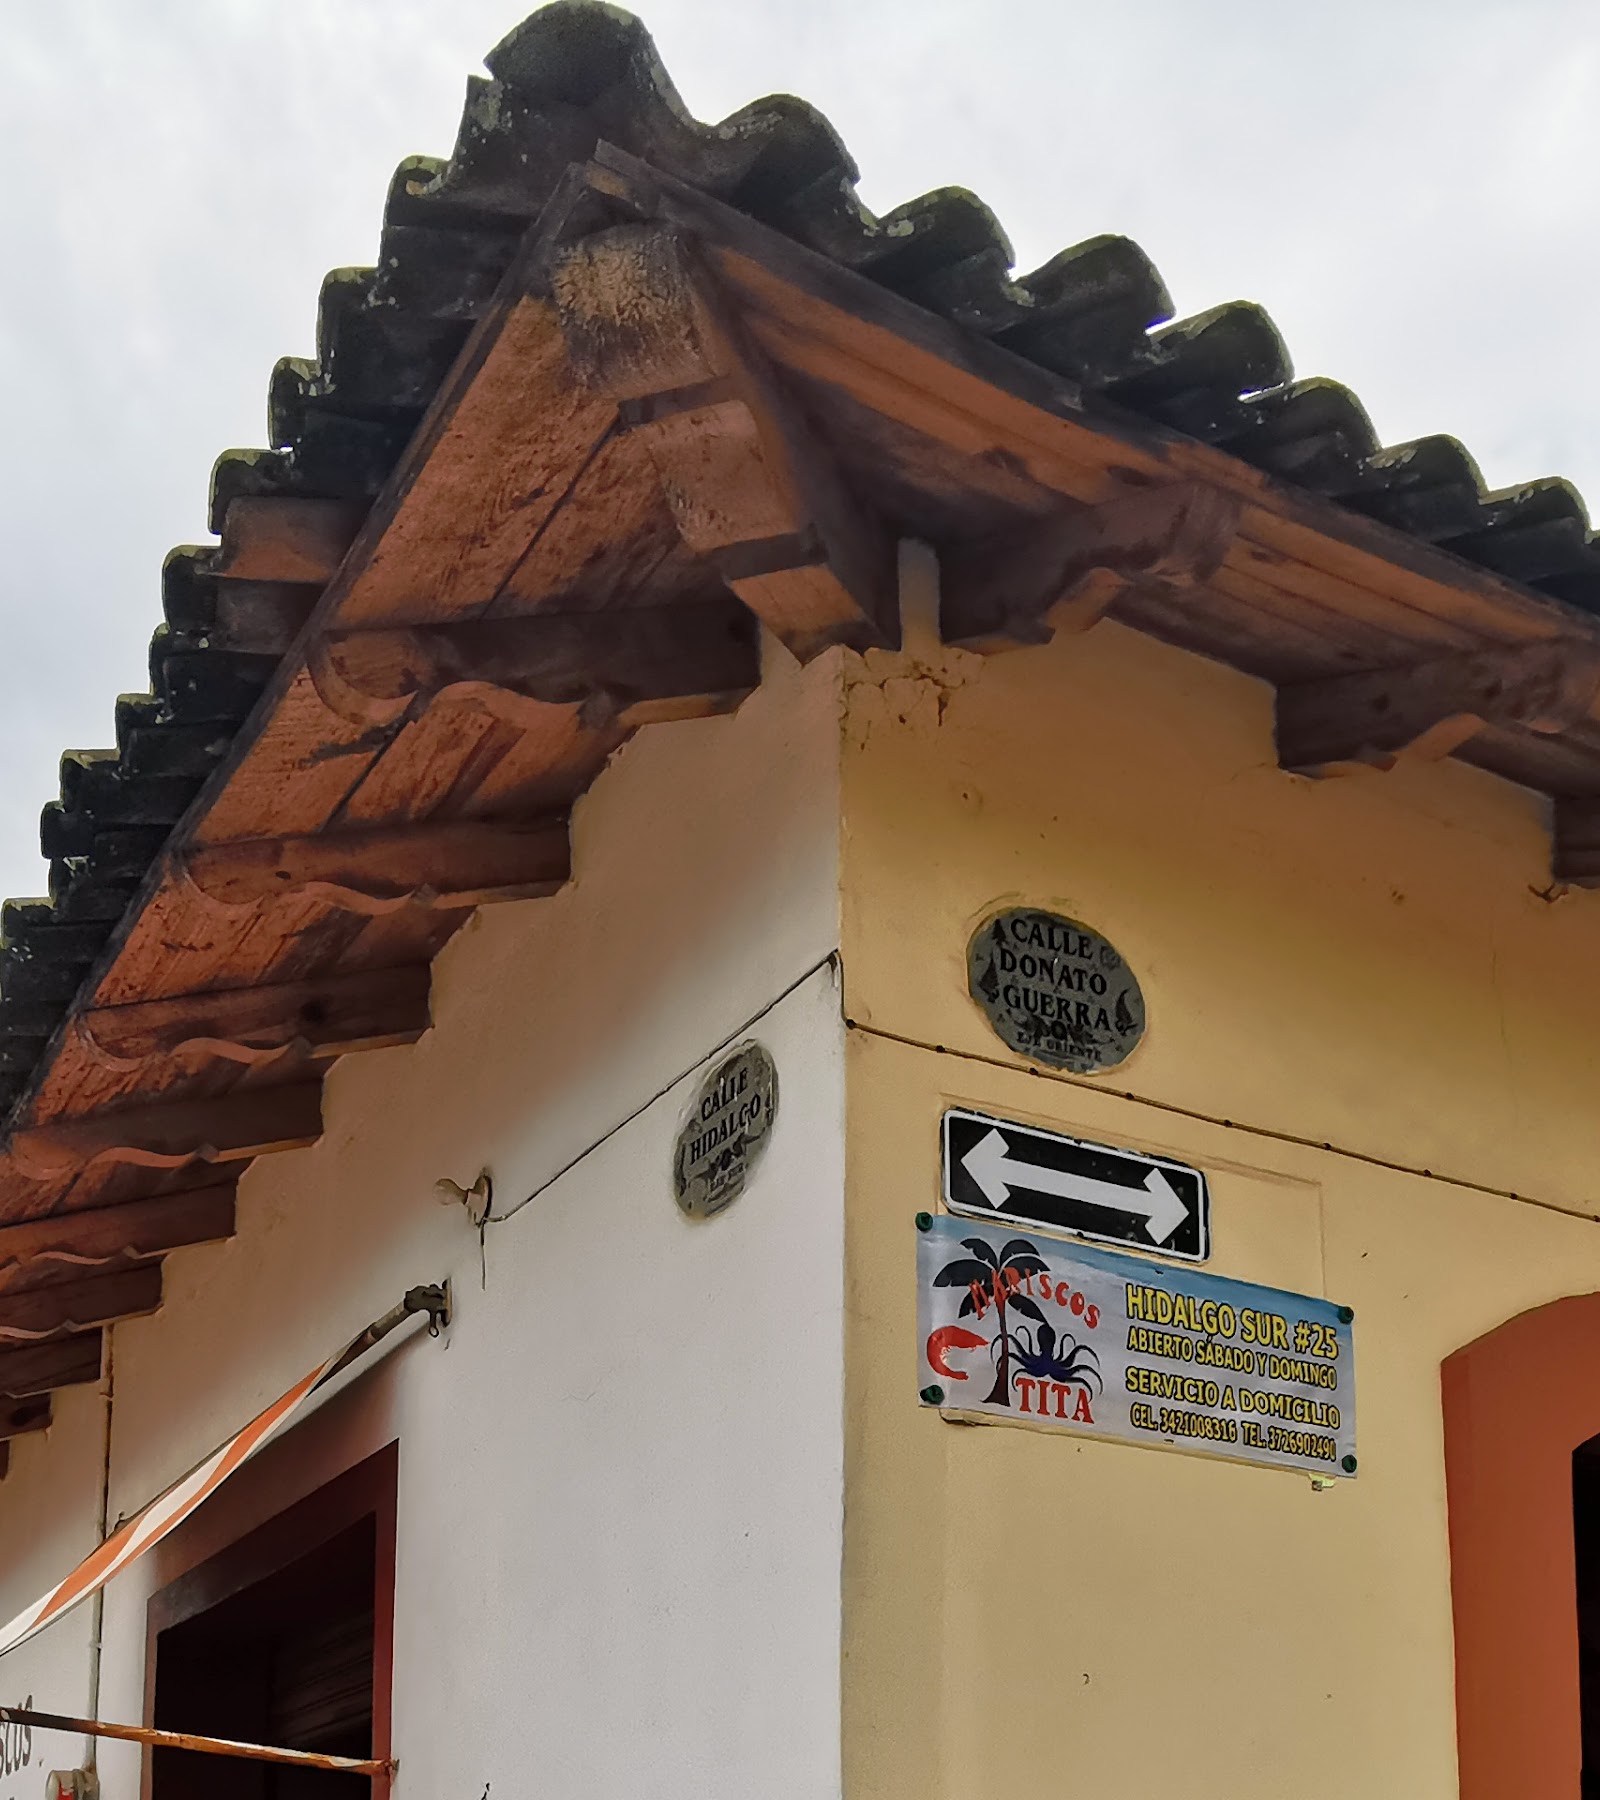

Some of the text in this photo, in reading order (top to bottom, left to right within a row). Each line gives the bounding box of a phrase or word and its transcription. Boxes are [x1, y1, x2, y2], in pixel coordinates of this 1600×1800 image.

[1010, 918, 1094, 960] CALLE
[999, 947, 1107, 996] DONATO
[1003, 985, 1112, 1031] GUERRA
[702, 1067, 749, 1121] CALLE
[690, 1094, 761, 1165] HIDALGO
[969, 1267, 1100, 1329] MARISCOS
[1126, 1283, 1339, 1360] HIDALGO SUR #25
[1127, 1326, 1338, 1390] ABIERTO SÁBADO Y DOMINGO
[1015, 1377, 1094, 1424] TITA
[1125, 1366, 1340, 1429] SERVICIO A DOMICILIO
[1130, 1402, 1158, 1430] CEL.
[1241, 1421, 1267, 1448] TEL.
